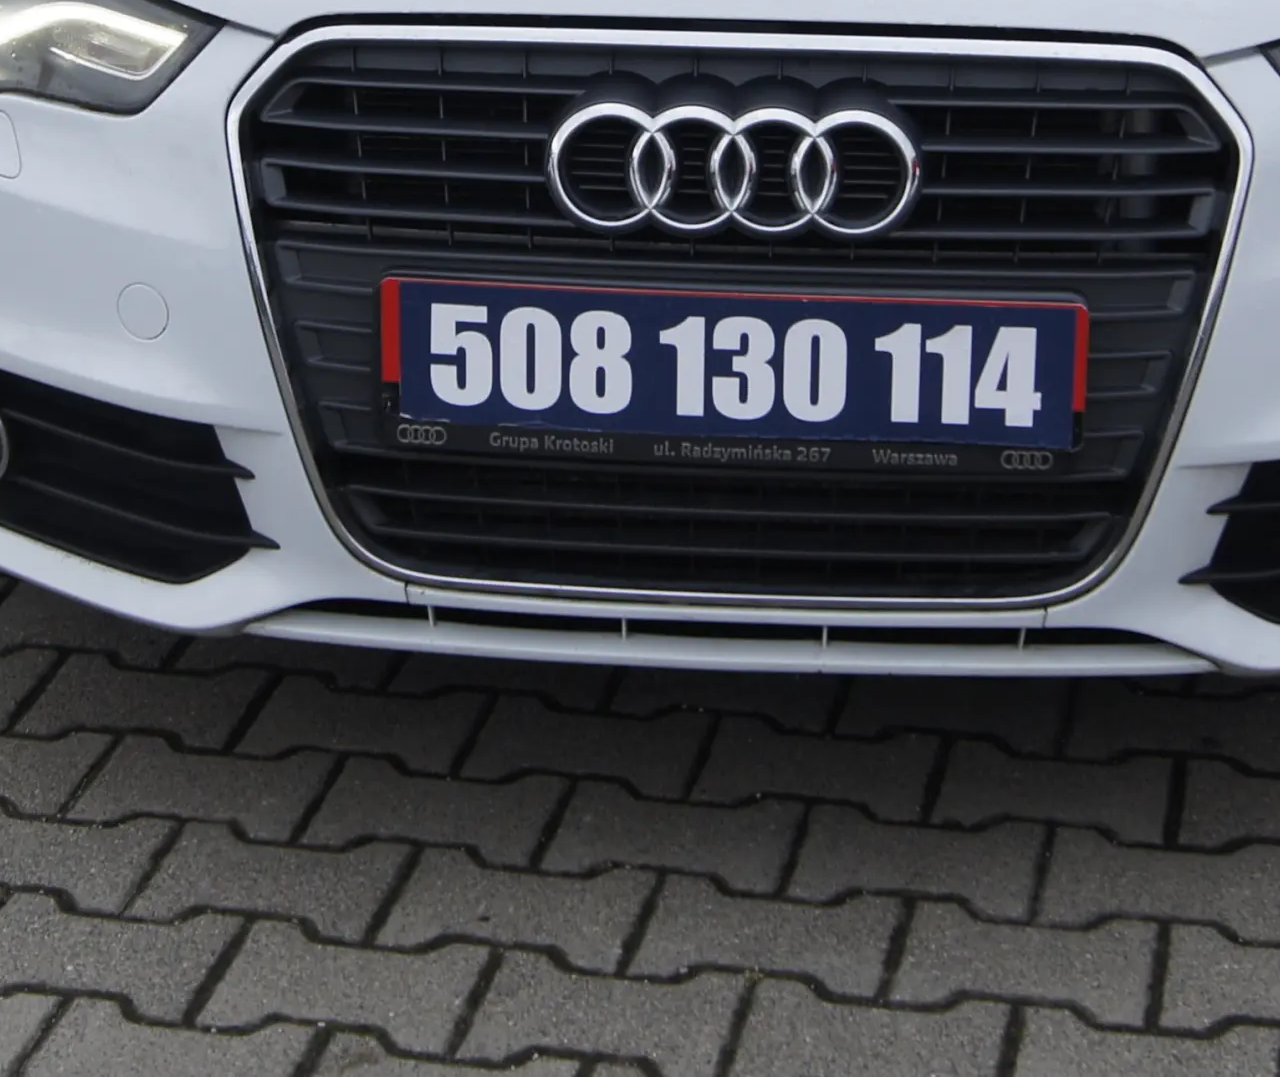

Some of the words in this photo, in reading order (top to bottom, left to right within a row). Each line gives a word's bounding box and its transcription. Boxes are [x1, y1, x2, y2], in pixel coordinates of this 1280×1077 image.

[430, 303, 633, 415] 508
[659, 315, 848, 423] 130
[874, 322, 1042, 428] 114
[489, 431, 539, 450] Grupa
[544, 434, 615, 454] Krotoski
[654, 441, 676, 457] ul.
[681, 442, 792, 463] Radzymińska
[796, 447, 832, 463] 267
[872, 448, 959, 466] Warszawa
